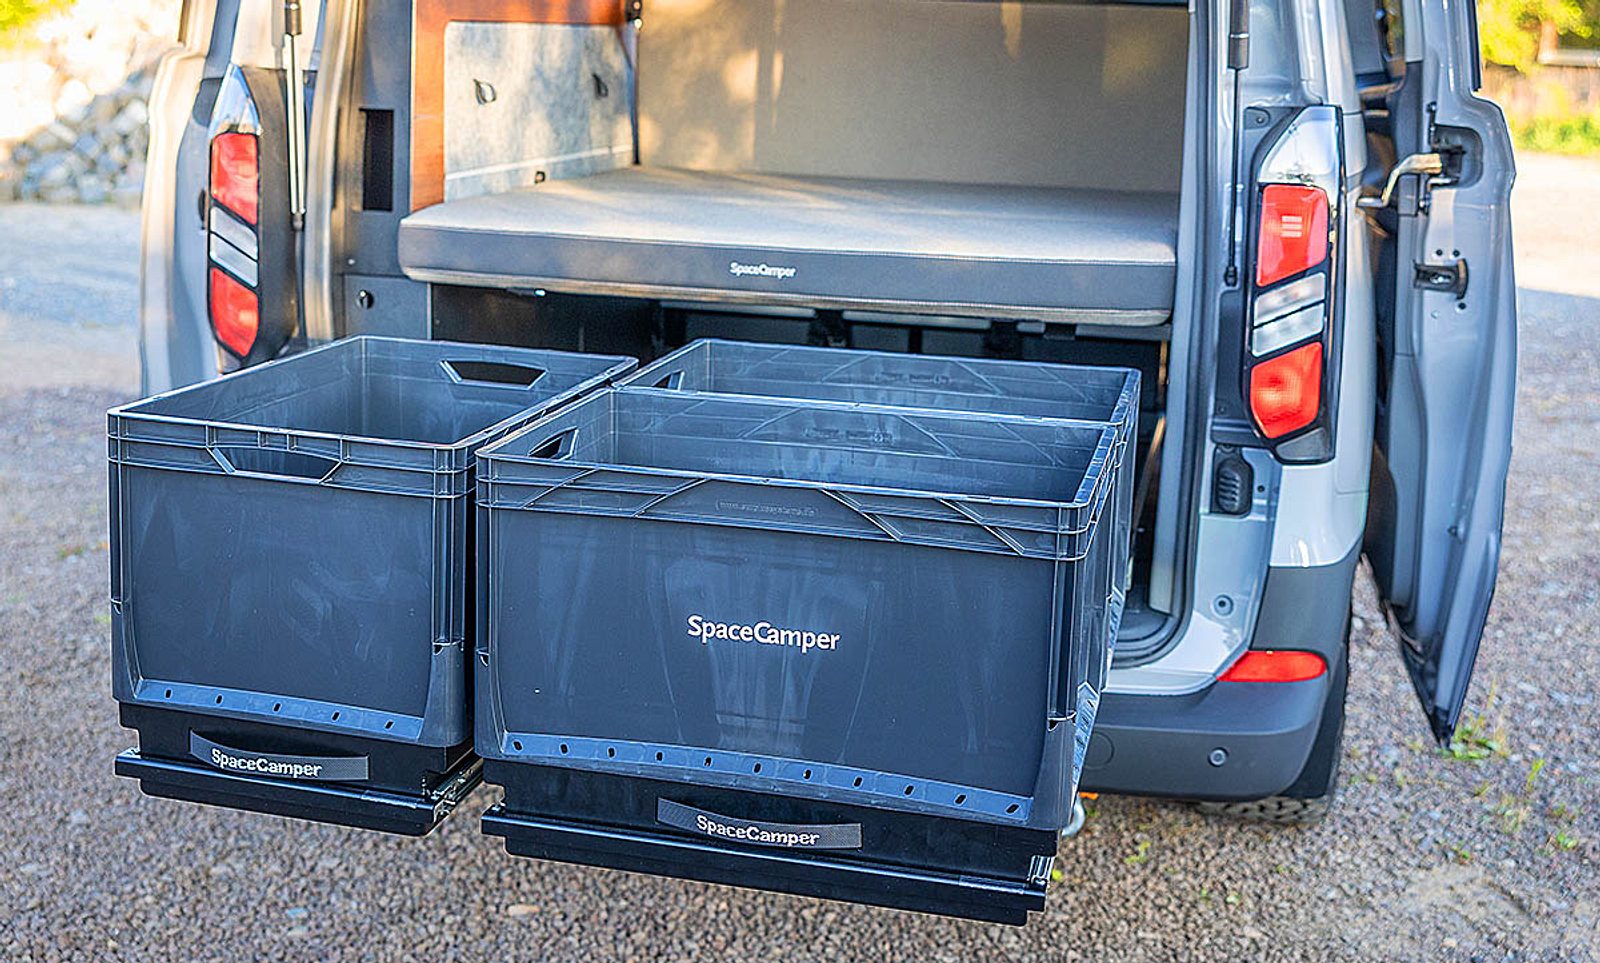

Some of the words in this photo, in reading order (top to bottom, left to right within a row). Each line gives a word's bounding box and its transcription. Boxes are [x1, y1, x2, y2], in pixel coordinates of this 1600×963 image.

[729, 261, 796, 280] SpaceCamper
[687, 615, 840, 653] SpaceCamper
[211, 748, 323, 778] SpaceCamper
[696, 814, 820, 847] SpaceCamper
